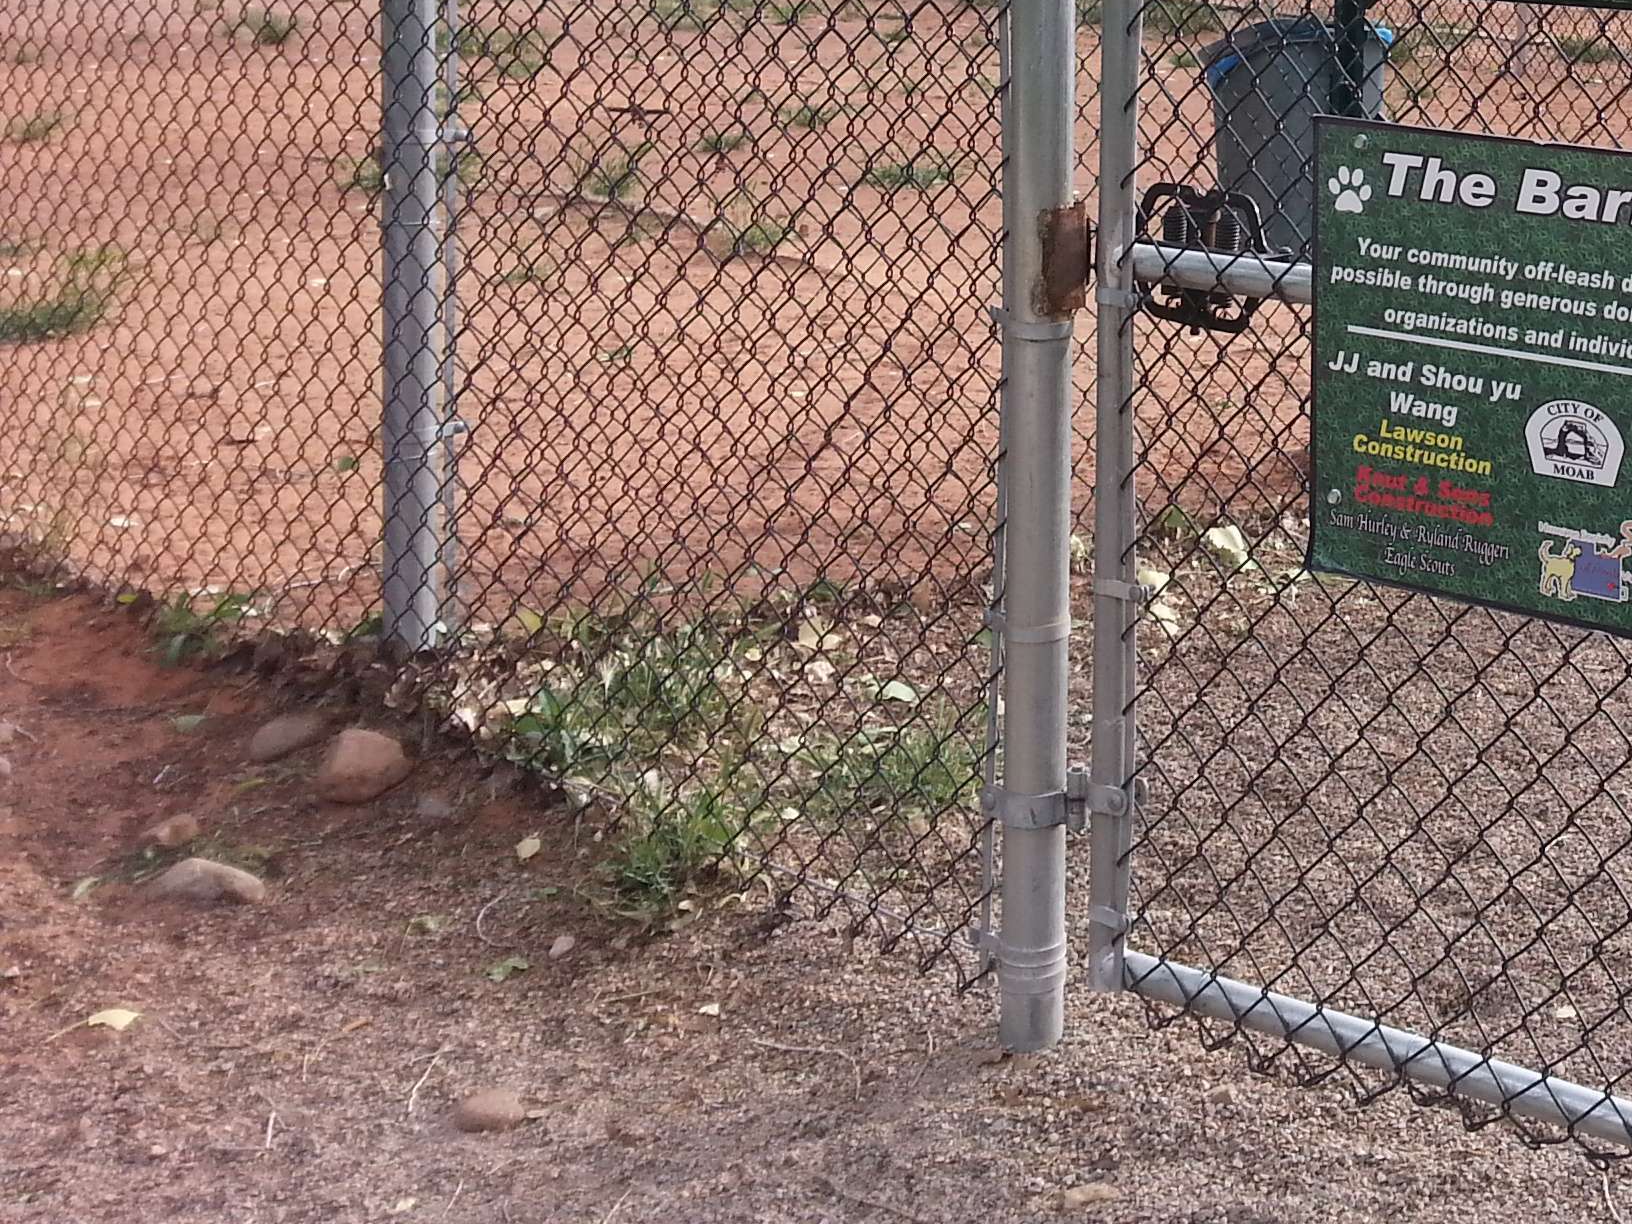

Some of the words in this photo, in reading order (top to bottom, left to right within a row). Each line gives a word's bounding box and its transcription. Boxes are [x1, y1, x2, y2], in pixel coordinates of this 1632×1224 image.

[1381, 152, 1497, 208] The
[1357, 237, 1402, 261] Your
[1407, 247, 1518, 281] community
[1524, 261, 1614, 290] off-leash
[1330, 265, 1412, 290] possible
[1418, 274, 1495, 304] through
[1500, 289, 1597, 317] generous
[1384, 307, 1519, 342] organizations
[1524, 328, 1563, 348] and
[1328, 350, 1360, 374] JJ
[1367, 360, 1414, 383] and
[1419, 364, 1483, 394] Shou
[1489, 379, 1522, 402] yu
[1390, 391, 1458, 427] Wang
[1547, 402, 1580, 416] CITY
[1583, 408, 1605, 424] OF
[1353, 434, 1493, 476] Construction
[1379, 418, 1463, 451] Lawson
[1553, 463, 1595, 481] MOAB
[1353, 484, 1494, 527] Construction
[1329, 508, 1354, 529] Sam
[1356, 510, 1397, 542] Hurley
[1400, 523, 1412, 540] &
[1415, 525, 1462, 551] Ryland
[1462, 533, 1510, 566] Ruggeri
[1384, 543, 1416, 576] Eagle
[1419, 550, 1456, 577] Scouts
